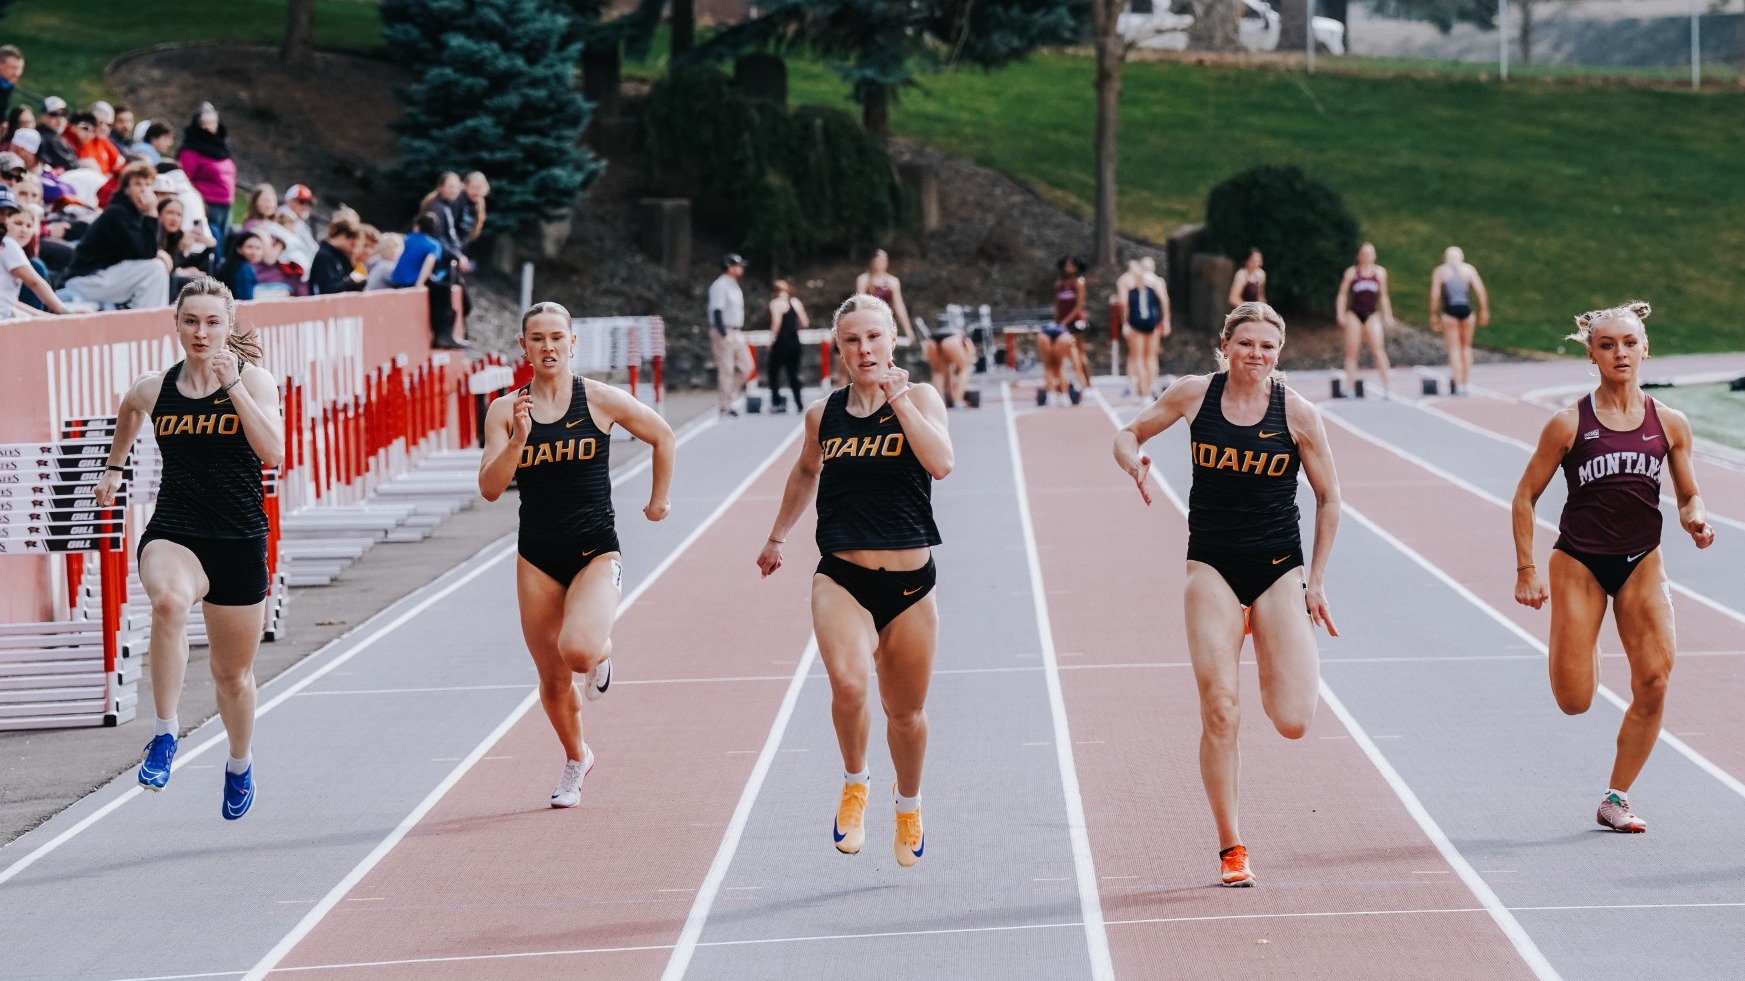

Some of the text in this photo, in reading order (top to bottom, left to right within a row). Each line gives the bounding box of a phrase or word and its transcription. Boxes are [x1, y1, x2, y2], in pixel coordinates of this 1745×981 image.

[81, 446, 105, 455] GILL
[518, 438, 596, 469] DAHO
[78, 459, 102, 468] GILL
[1192, 441, 1290, 477] IDAHO
[71, 512, 95, 521] GILL
[70, 526, 94, 535] GILL
[67, 540, 91, 549] GILL
